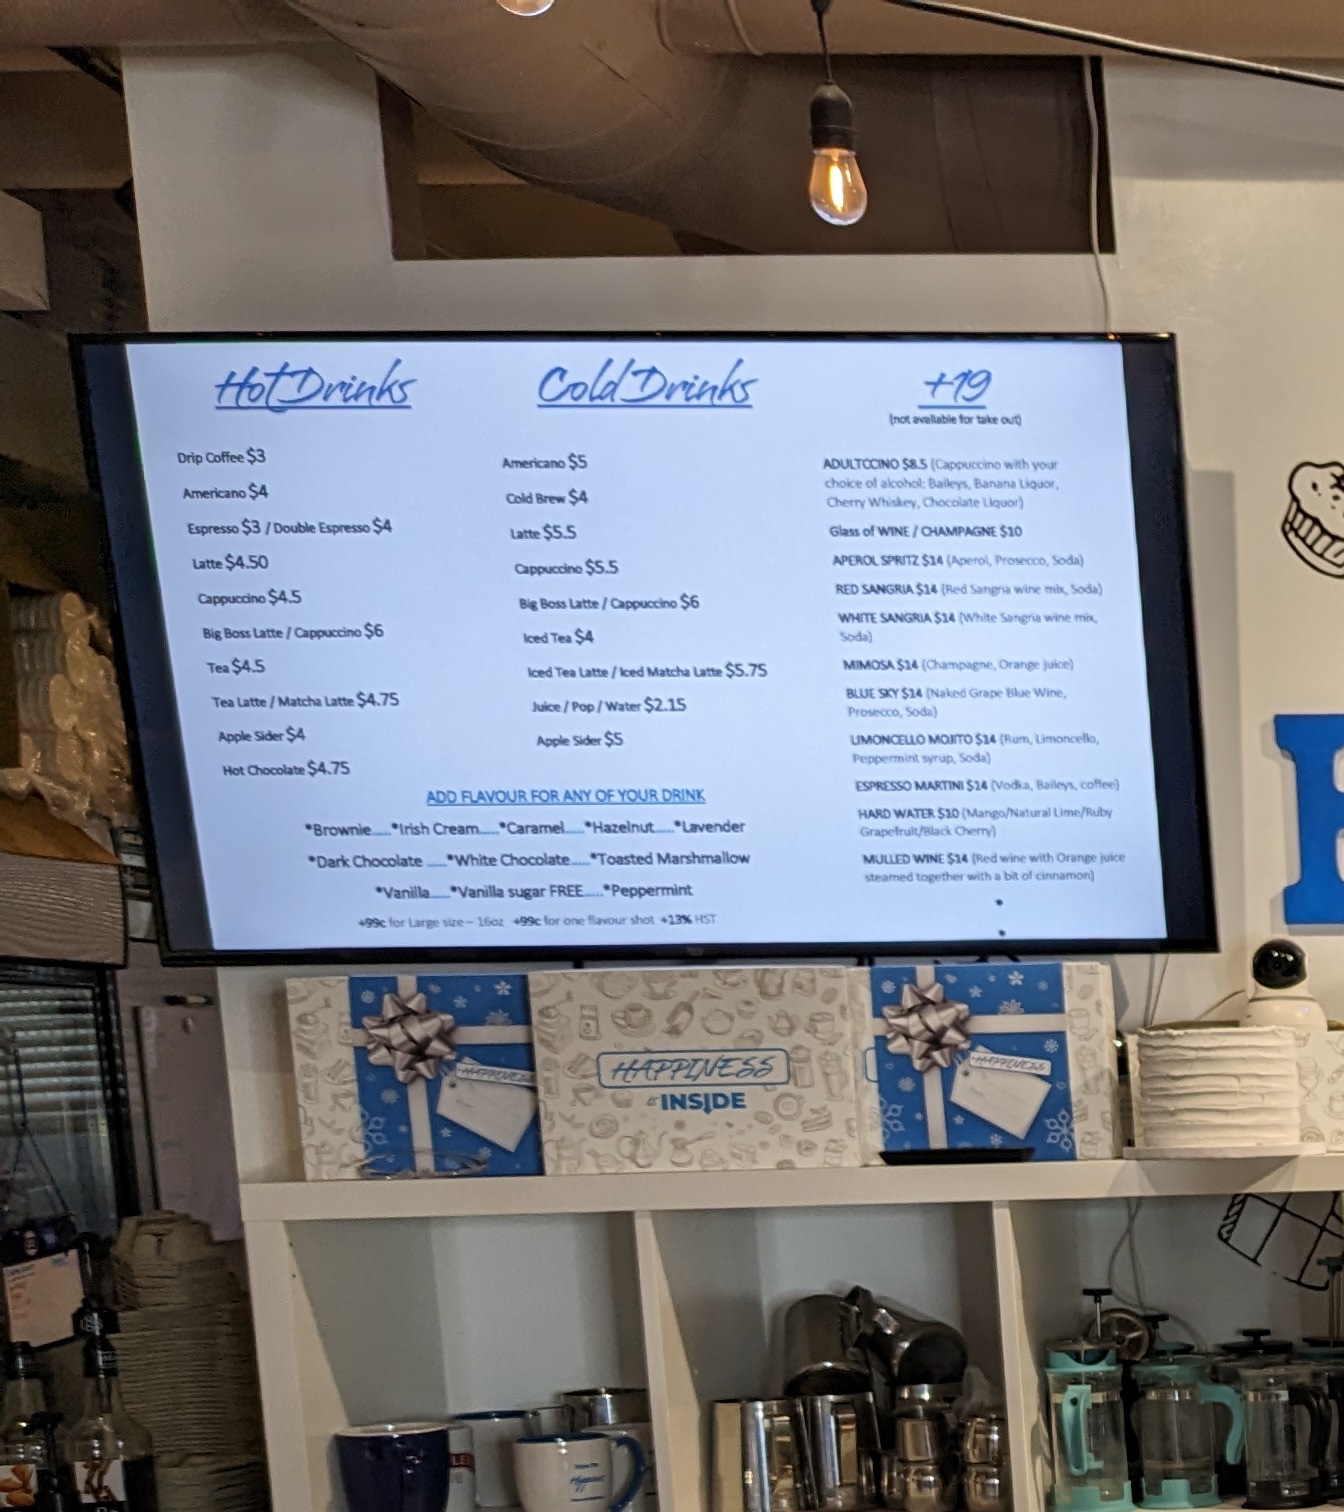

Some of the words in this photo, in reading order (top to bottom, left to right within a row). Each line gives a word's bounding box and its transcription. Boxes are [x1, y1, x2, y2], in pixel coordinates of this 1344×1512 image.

[215, 362, 289, 412] Hot
[291, 359, 415, 403] Drinks
[539, 359, 627, 403] Cold
[630, 359, 758, 404] Drinks
[924, 369, 992, 402] +19
[177, 452, 203, 464] Drip
[206, 451, 244, 463] Coffee
[246, 447, 266, 464] $3
[502, 459, 566, 468] Americano
[568, 453, 587, 470] $5
[902, 458, 927, 470] $8.5
[183, 489, 246, 499] Americano
[249, 483, 268, 500] $4
[187, 524, 239, 534] Espresso
[241, 518, 261, 535] $3
[265, 521, 271, 535] /
[273, 522, 316, 533] Double
[318, 523, 370, 533] Espresso
[372, 517, 392, 534] $4
[192, 559, 223, 569] Latte
[225, 554, 269, 570] $4.50
[197, 594, 266, 604] Cappuccino
[268, 589, 301, 605] $4.5
[223, 766, 245, 776] Hot
[247, 765, 305, 775] Chocolate
[307, 761, 350, 776] $4.75
[426, 790, 459, 806] ADD
[461, 790, 530, 806] FLAVOUR
[530, 790, 561, 806] FOR
[561, 790, 594, 805] ANY
[593, 789, 617, 805] OF
[617, 789, 661, 805] YOUR
[660, 788, 705, 805] DRINK
[612, 1055, 776, 1083] HAPPINESS
[661, 1092, 746, 1114] INSIDE
